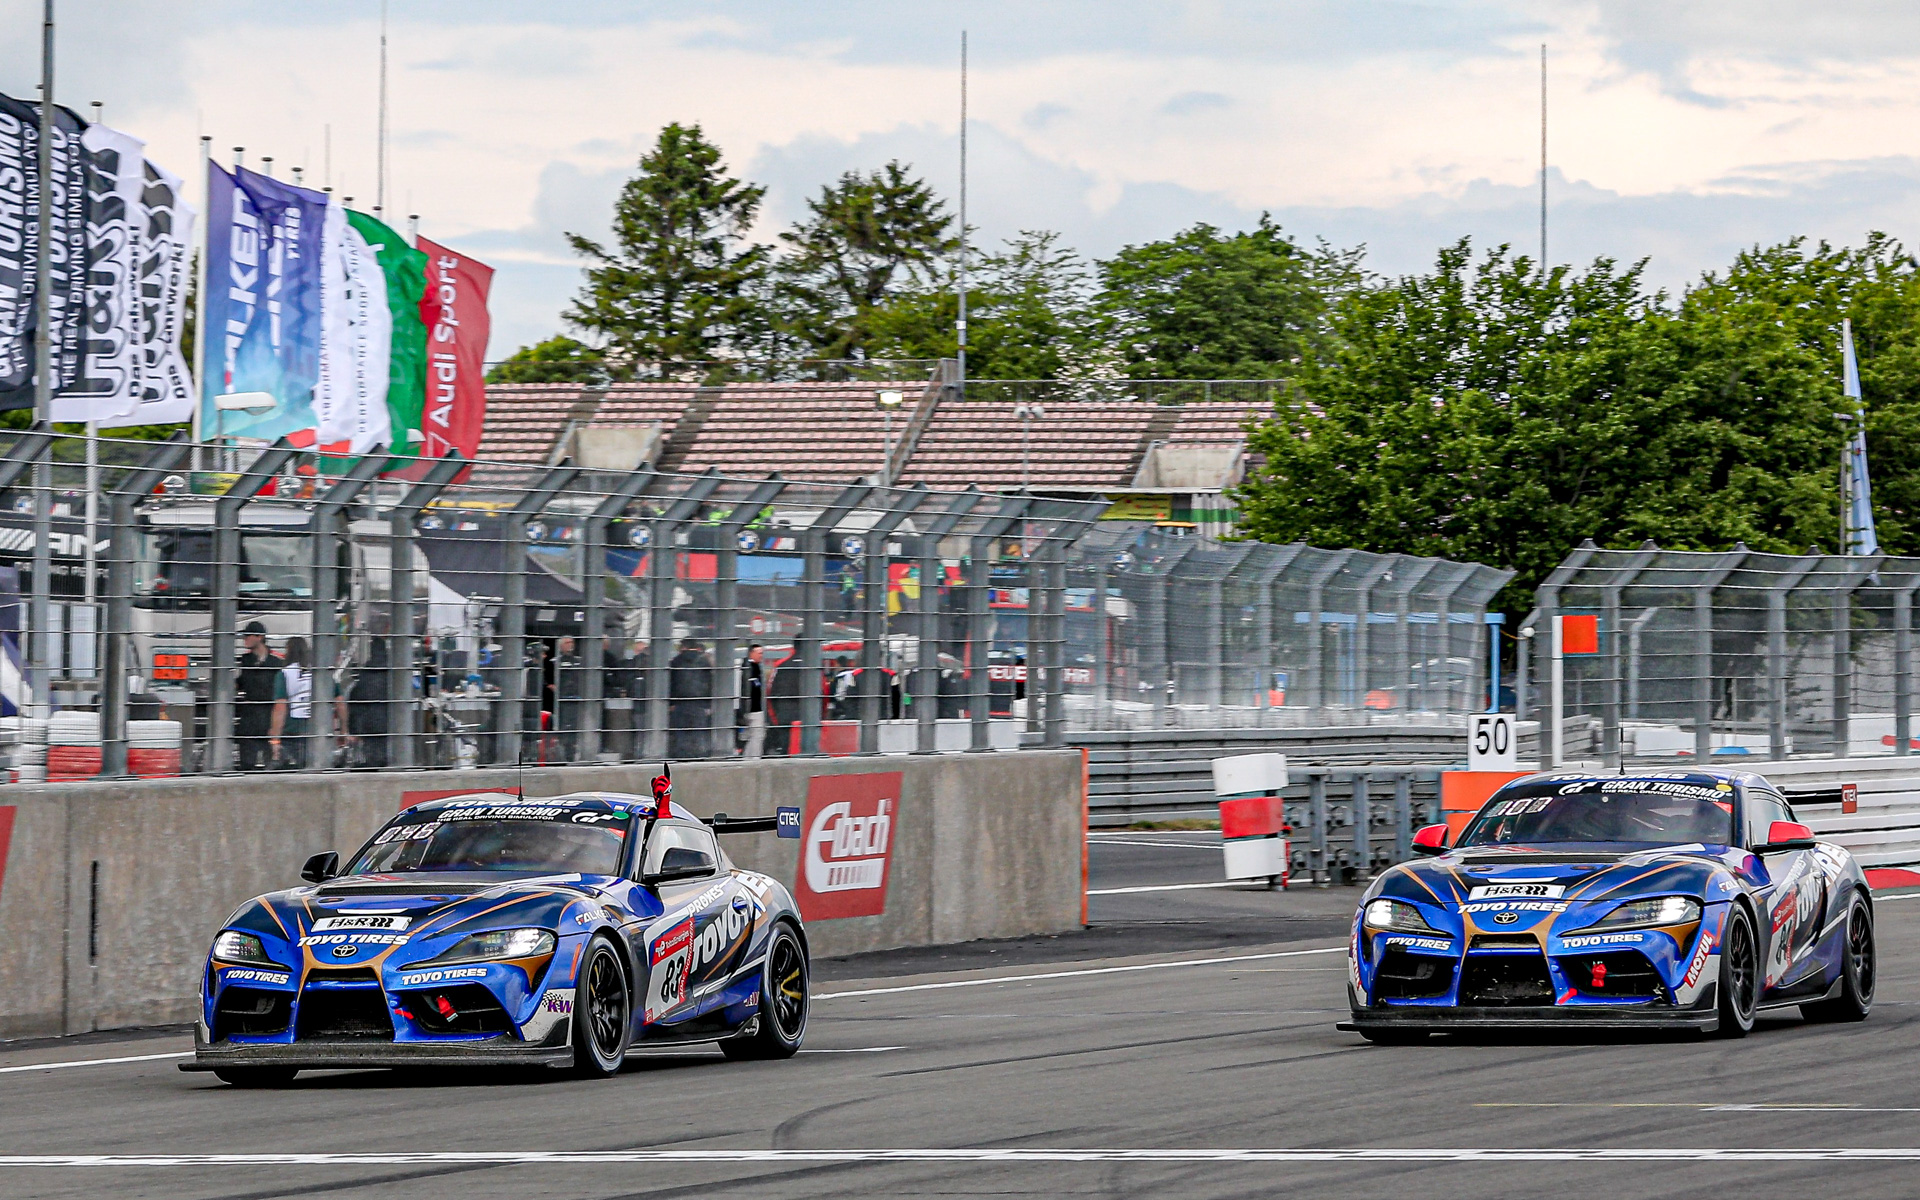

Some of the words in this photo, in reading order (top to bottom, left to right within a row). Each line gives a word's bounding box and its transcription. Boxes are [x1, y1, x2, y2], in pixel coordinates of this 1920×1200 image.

[68, 132, 84, 229] SIMULATOR
[20, 221, 40, 295] DRIVING
[69, 233, 84, 304] DRIVING
[433, 255, 460, 345] Sport
[62, 307, 80, 350] REAL
[61, 354, 77, 388] THE
[429, 353, 456, 428] Audi
[1474, 718, 1508, 755] 50
[1601, 781, 1649, 790] GRAN
[1651, 782, 1725, 799] TURISMO
[438, 808, 485, 819] GRAN
[486, 806, 563, 817] TURISMO
[779, 812, 799, 826] CTEK
[1484, 885, 1524, 896] H&R
[686, 884, 725, 918] PROXES
[1457, 902, 1504, 915] TOYO
[1504, 901, 1569, 914] TIRES
[328, 917, 373, 929] H&R
[297, 934, 347, 947] TOYO
[346, 934, 410, 946] TIRES
[1385, 936, 1416, 948] TOYO
[1415, 938, 1452, 951] TIRES
[1562, 935, 1601, 949] TOYO
[1601, 933, 1644, 945] TIRES
[1686, 933, 1714, 986] MOTUL
[225, 968, 254, 980] TOYO
[253, 970, 290, 985] TIRES
[401, 972, 438, 985] TOYO
[437, 967, 488, 982] TIRES
[547, 999, 574, 1014] KW
